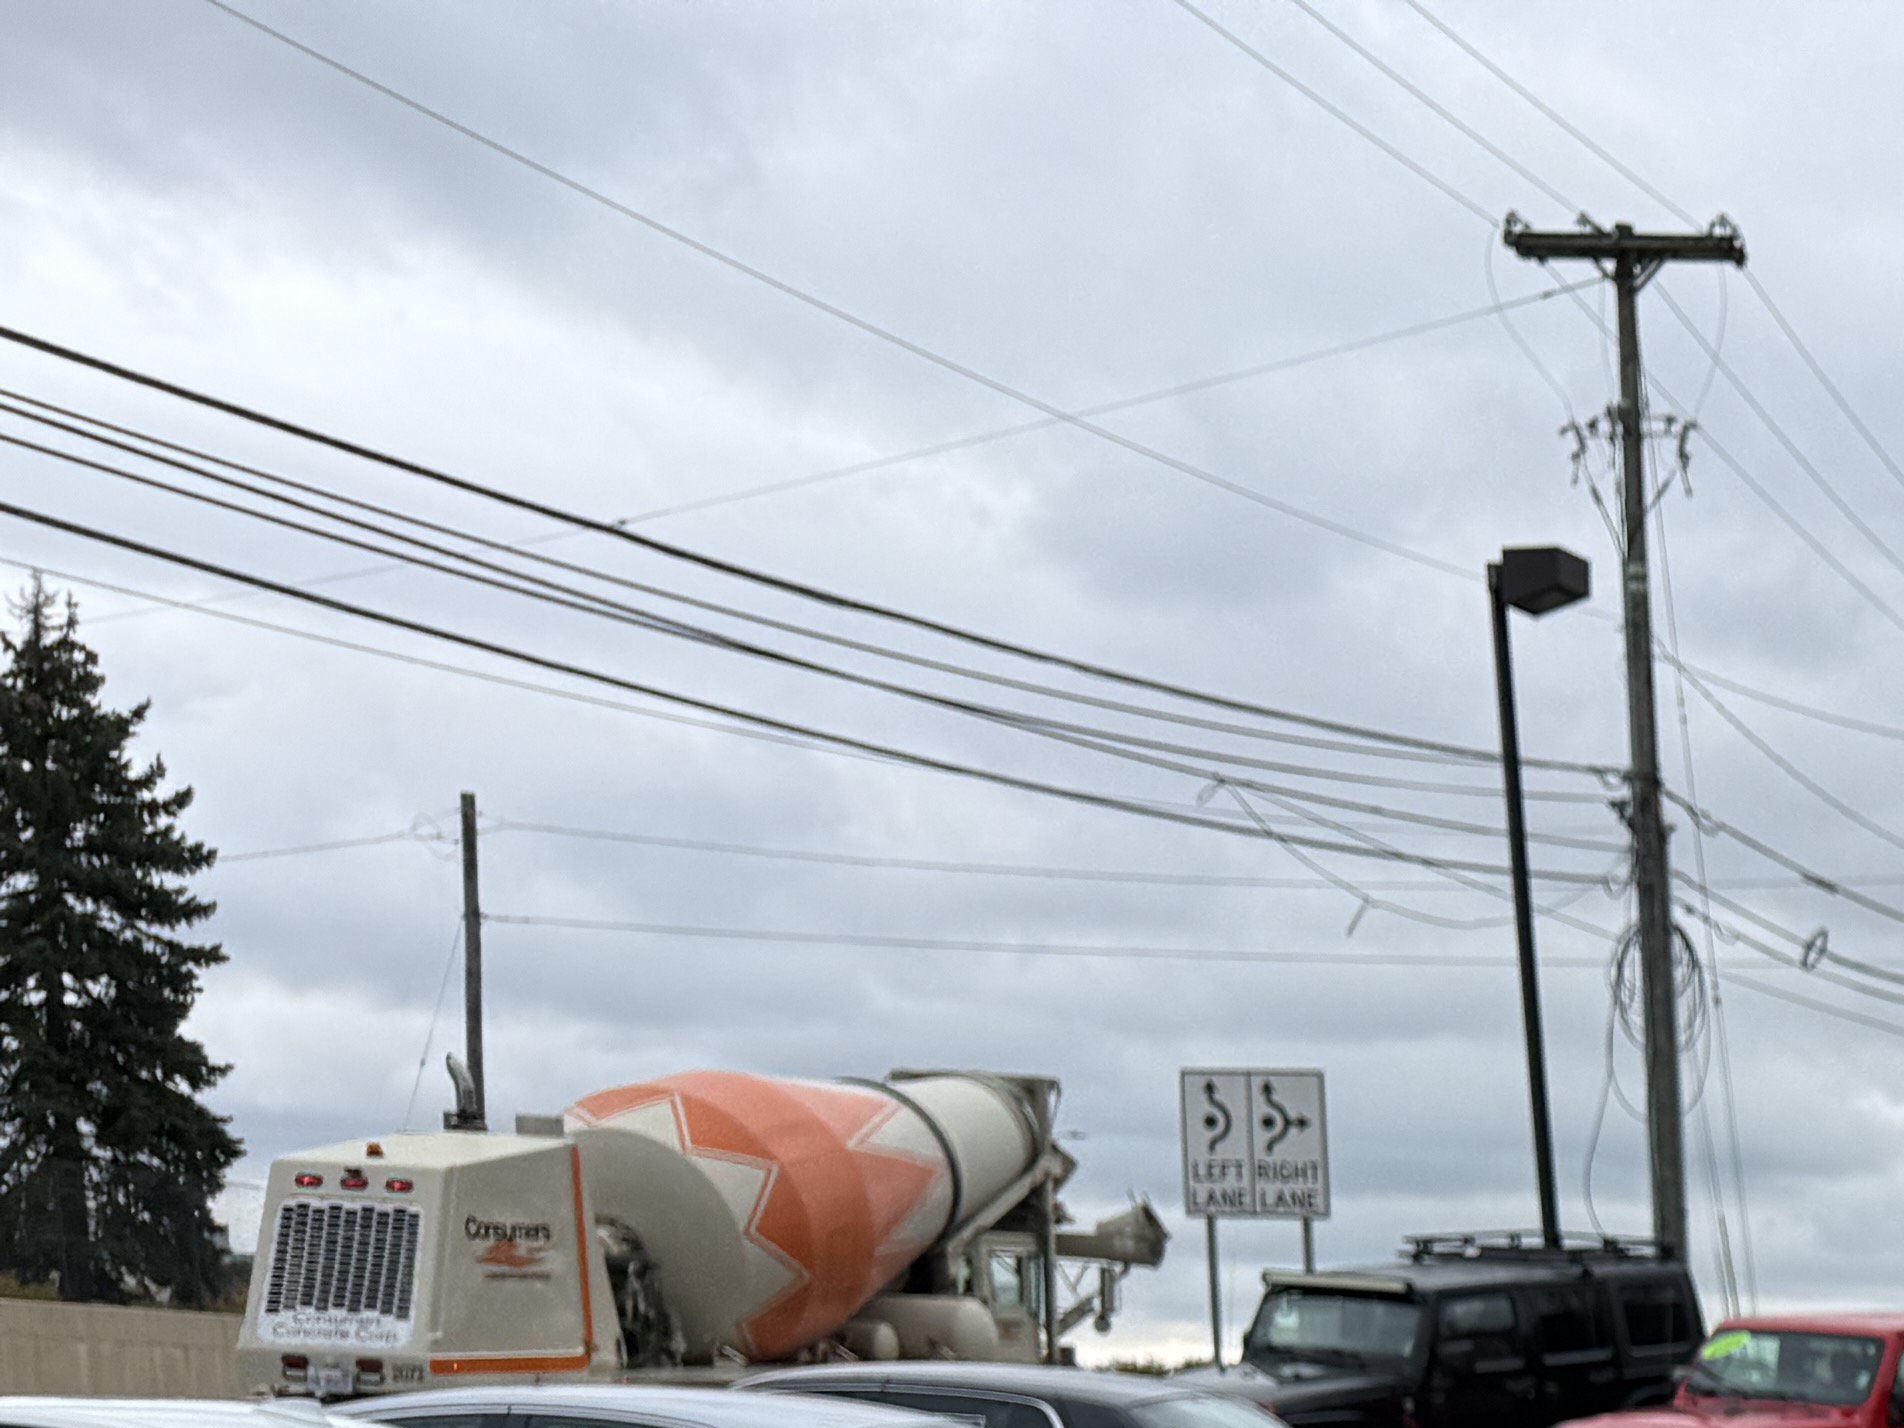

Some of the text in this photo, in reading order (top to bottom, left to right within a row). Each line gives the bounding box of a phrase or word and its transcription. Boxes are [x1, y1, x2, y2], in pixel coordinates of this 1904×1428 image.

[1191, 1159, 1243, 1184] LEFT
[1257, 1159, 1319, 1184] RIGHT
[1191, 1187, 1247, 1208] LANE
[1259, 1187, 1318, 1208] LANE
[464, 1214, 552, 1241] Consumers
